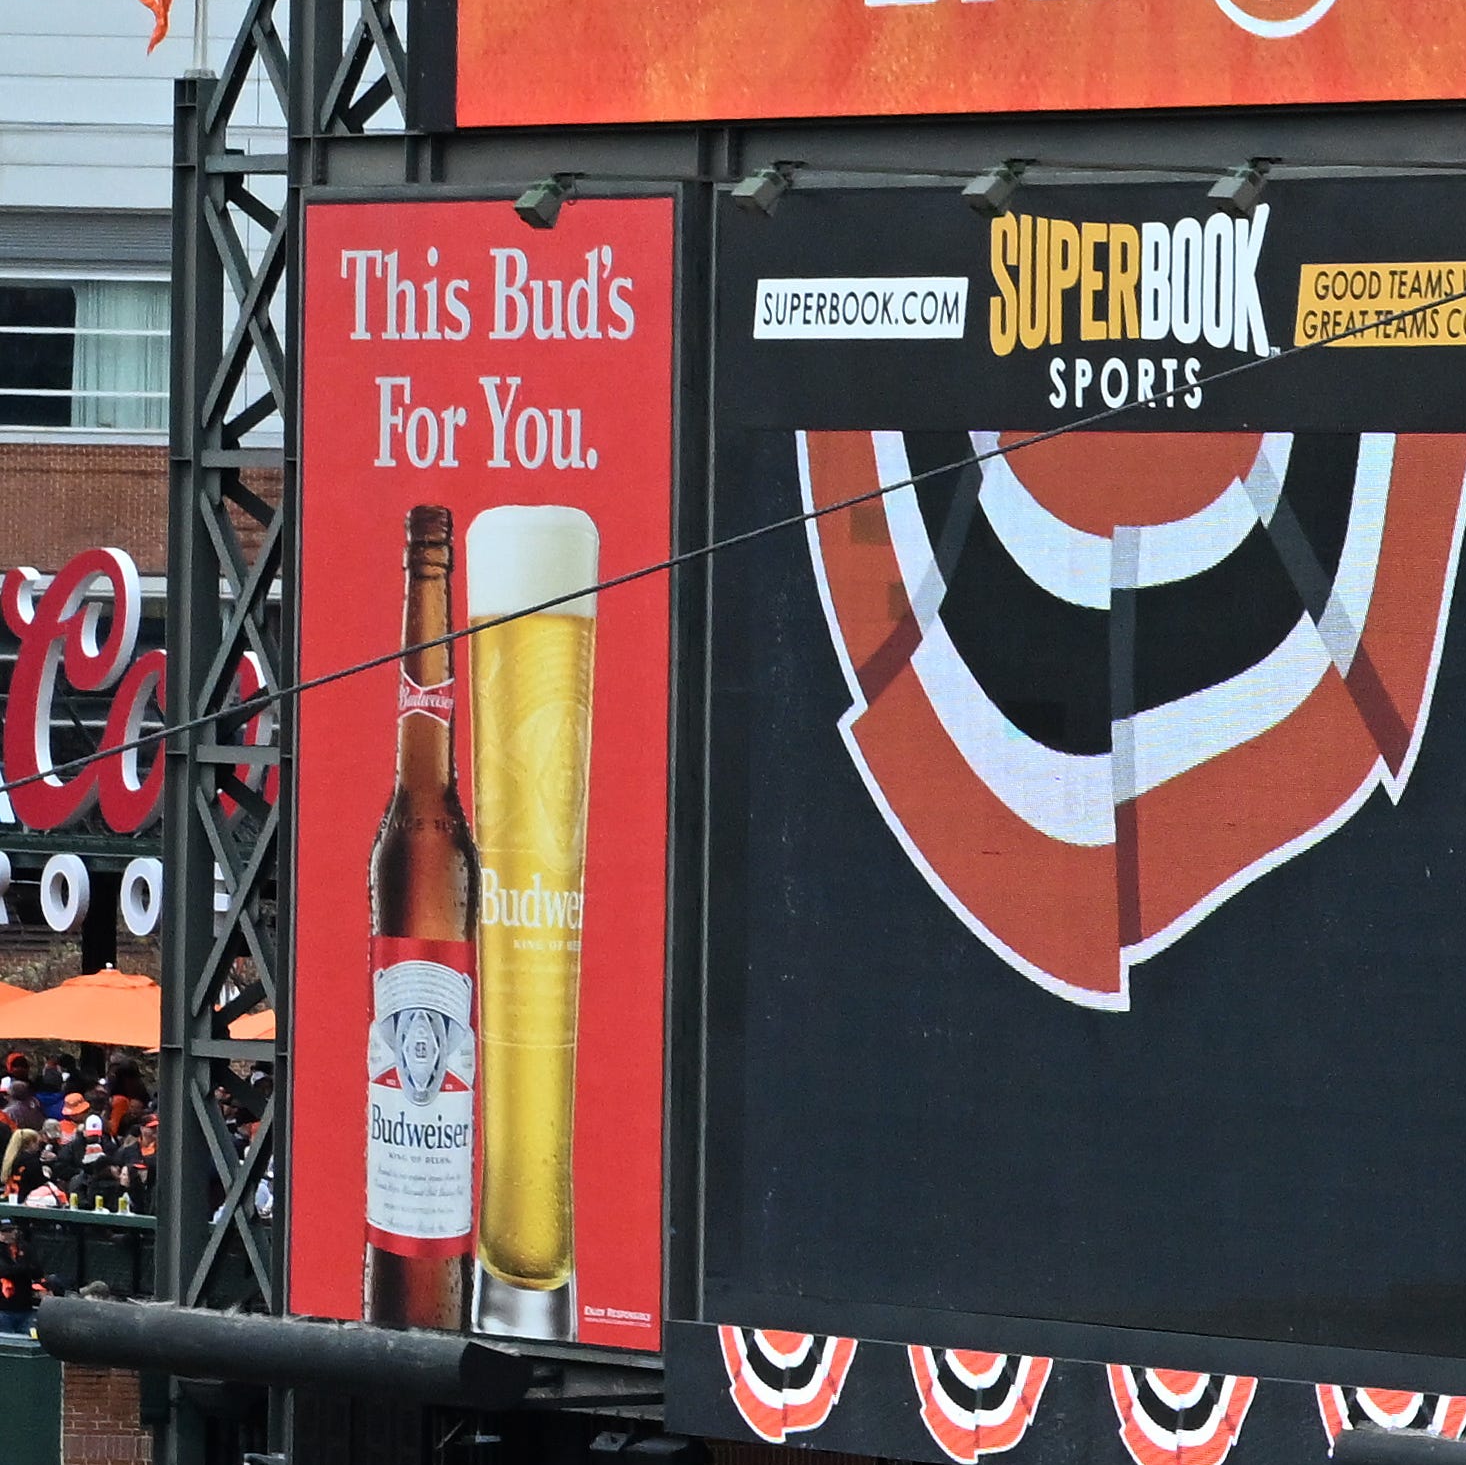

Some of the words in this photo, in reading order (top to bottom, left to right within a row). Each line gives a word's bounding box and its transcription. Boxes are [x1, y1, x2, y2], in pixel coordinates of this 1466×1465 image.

[340, 246, 472, 342] This
[488, 244, 636, 342] Bud's
[988, 203, 1271, 358] SUPERBOOK
[1313, 270, 1381, 302] GOOD
[1386, 269, 1456, 302] TEAMS
[762, 289, 961, 326] SUPERBOOK.COM
[1302, 309, 1370, 341] GREAT
[1372, 309, 1441, 341] TEAMS
[1048, 357, 1203, 410] SPORTS
[374, 375, 468, 470] For
[478, 375, 598, 472] You.
[371, 1102, 469, 1150] Budweiser
